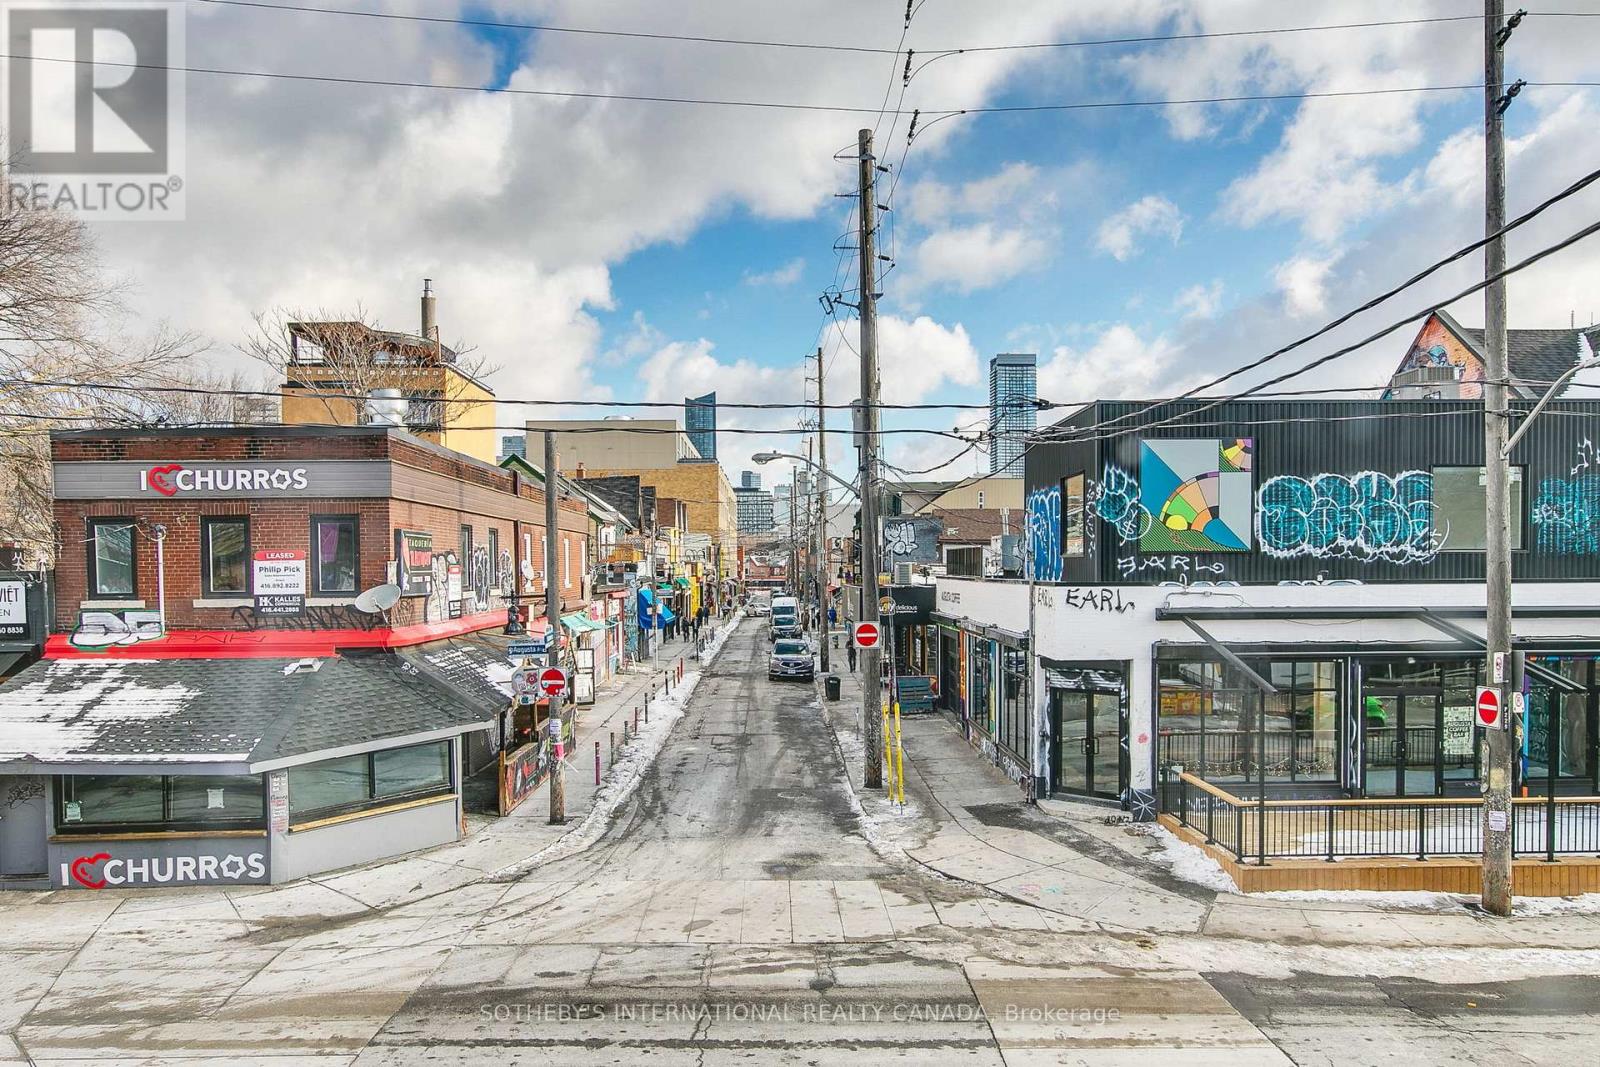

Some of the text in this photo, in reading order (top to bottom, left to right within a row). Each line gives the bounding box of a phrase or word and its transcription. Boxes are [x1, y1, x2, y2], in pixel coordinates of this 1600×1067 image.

[140, 468, 308, 491] I CHURROS
[258, 565, 301, 574] Philip Pick
[1066, 588, 1135, 614] EARL
[60, 853, 266, 886] I CHURROS
